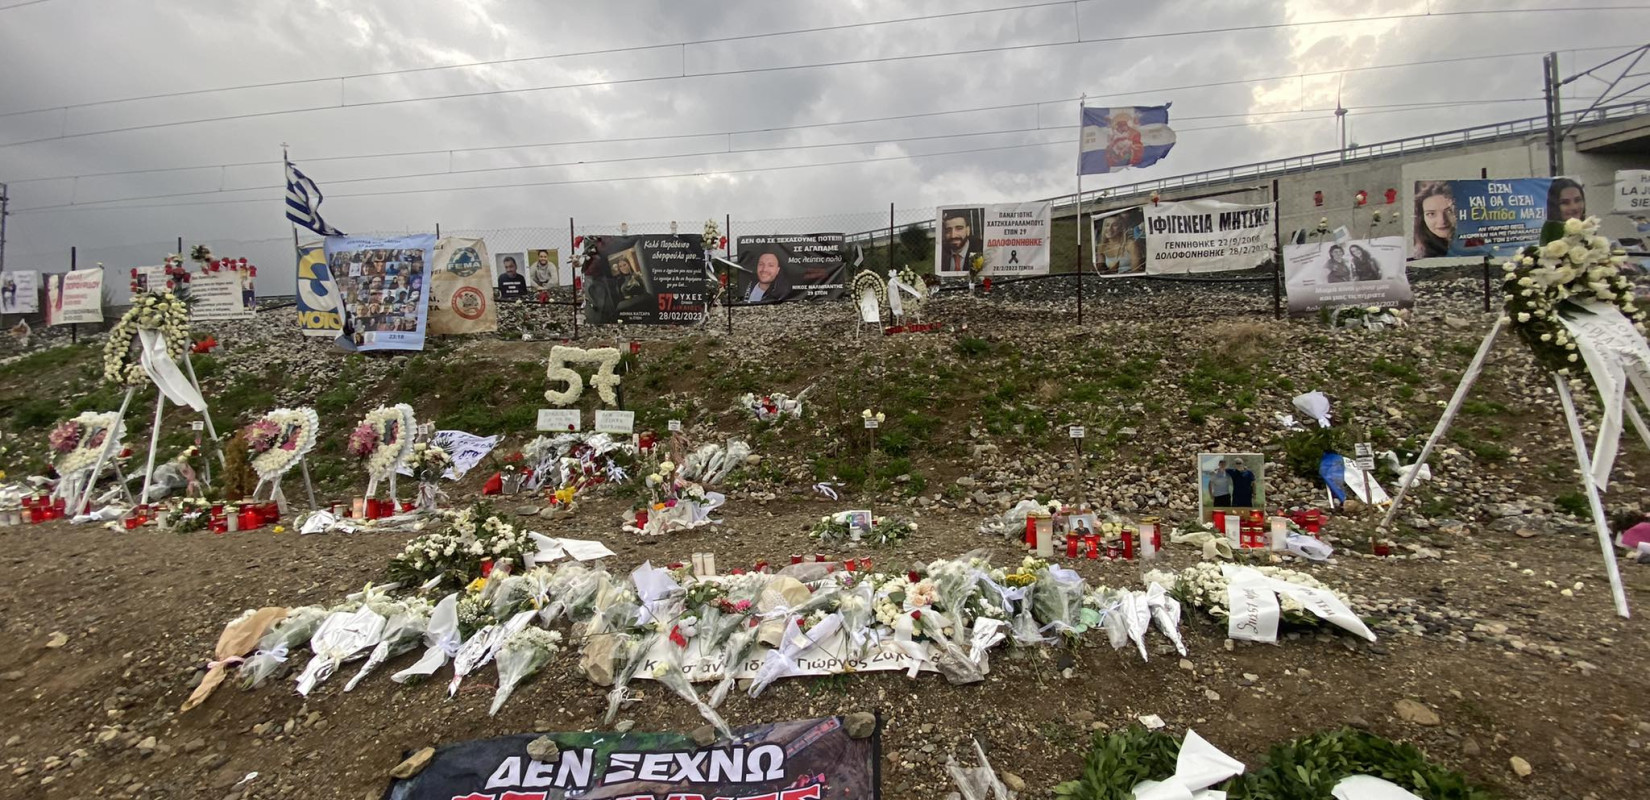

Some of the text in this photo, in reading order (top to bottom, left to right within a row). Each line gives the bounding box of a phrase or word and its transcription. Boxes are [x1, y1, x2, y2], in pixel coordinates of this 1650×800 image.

[1488, 183, 1512, 194] ΕΙΣΑΙ
[1622, 186, 1638, 196] LA
[1469, 195, 1535, 207] ΚΑΙ ΘΑ ΕΙΣΑΙ
[1631, 198, 1650, 207] SIE
[1459, 209, 1467, 220] Η
[1471, 206, 1516, 221] Ελπίδα
[1148, 213, 1213, 235] ΙΦΙΓΕΝΕΙΑ
[803, 244, 839, 252] ΑΓΑΠΑΜΕ
[1164, 239, 1216, 250] ΓΕΝΝΗΘΗΚΕ
[788, 257, 801, 265] Μας
[825, 254, 843, 263] πολύ
[1155, 248, 1226, 260] ΔΟΛΟΦΟΝΗΘΗΚΕ
[447, 261, 481, 269] FEMA
[658, 293, 673, 311] 57
[658, 311, 702, 321] 28/02/2023
[544, 345, 621, 407] 57
[797, 657, 867, 670] Γιώργος
[484, 743, 787, 791] ΔΕΝ ΞΕΧΝΩ
